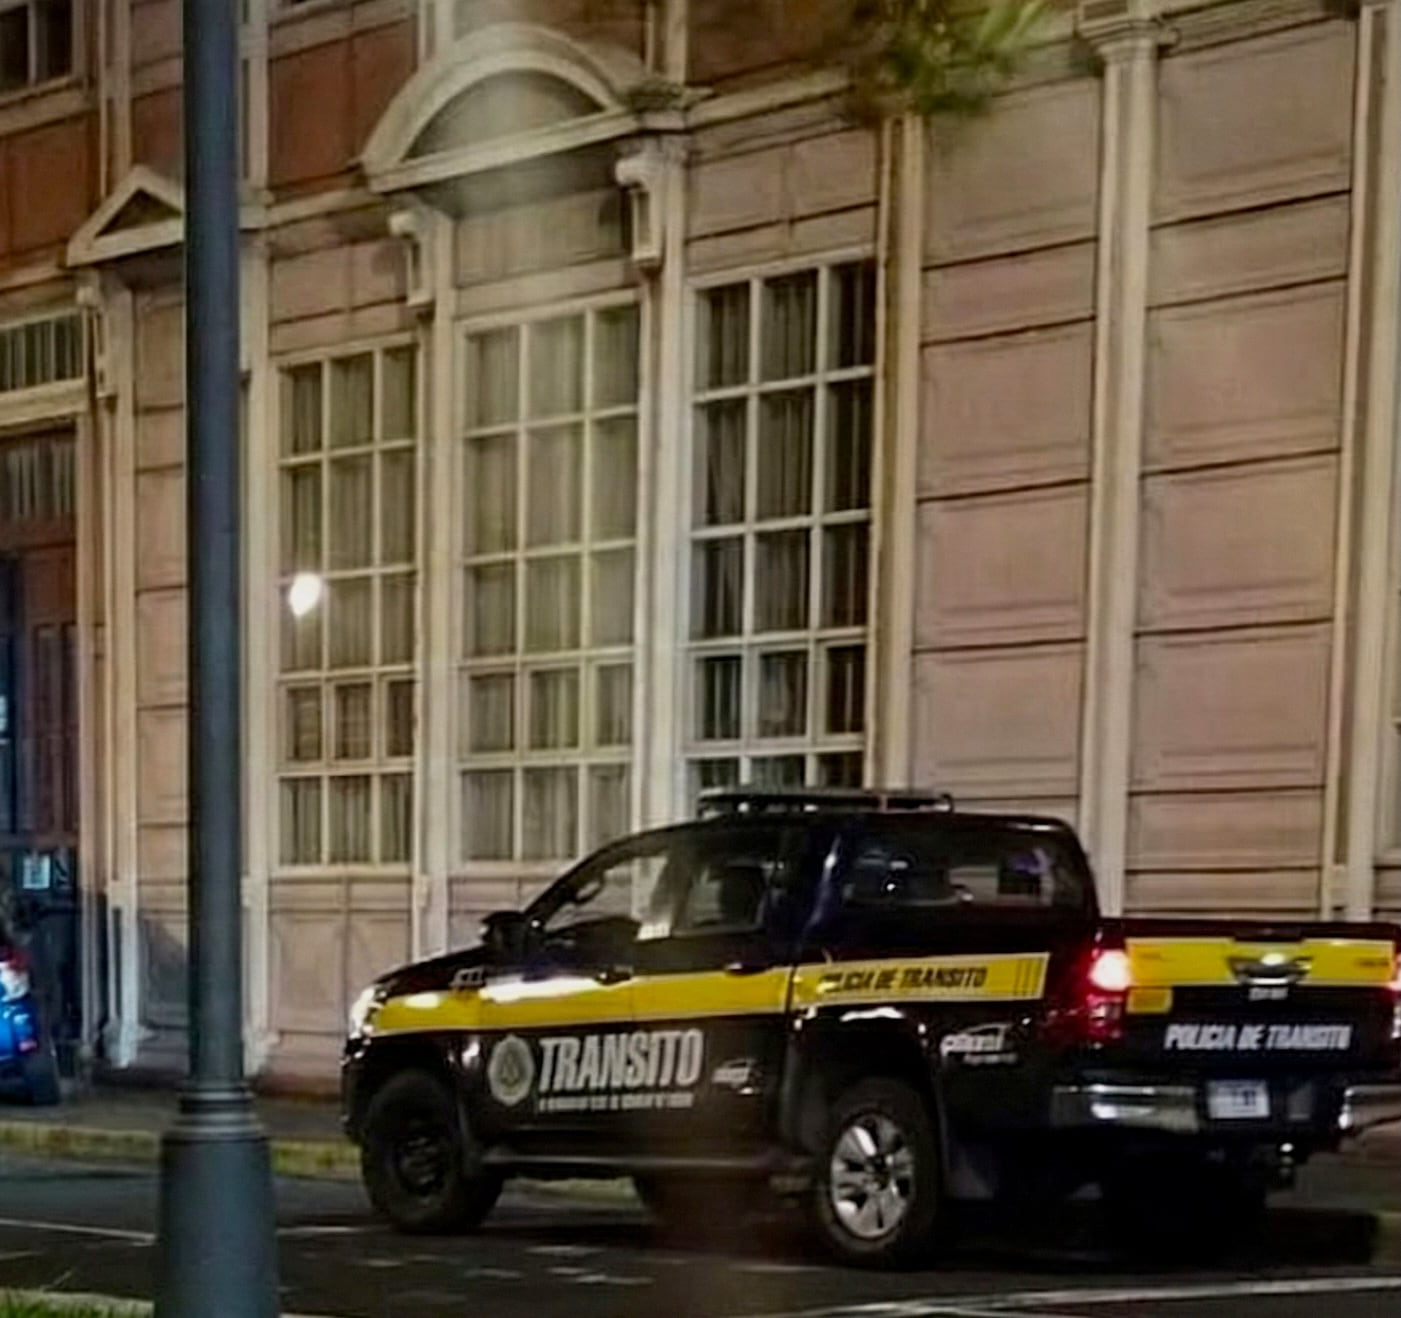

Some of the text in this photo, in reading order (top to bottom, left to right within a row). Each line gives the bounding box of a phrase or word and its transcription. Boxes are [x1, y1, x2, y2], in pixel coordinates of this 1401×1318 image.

[902, 966, 988, 989] TRANSITO
[1164, 1023, 1352, 1050] POLICIA DE TRANSITO
[538, 1028, 703, 1093] TRANSITO
